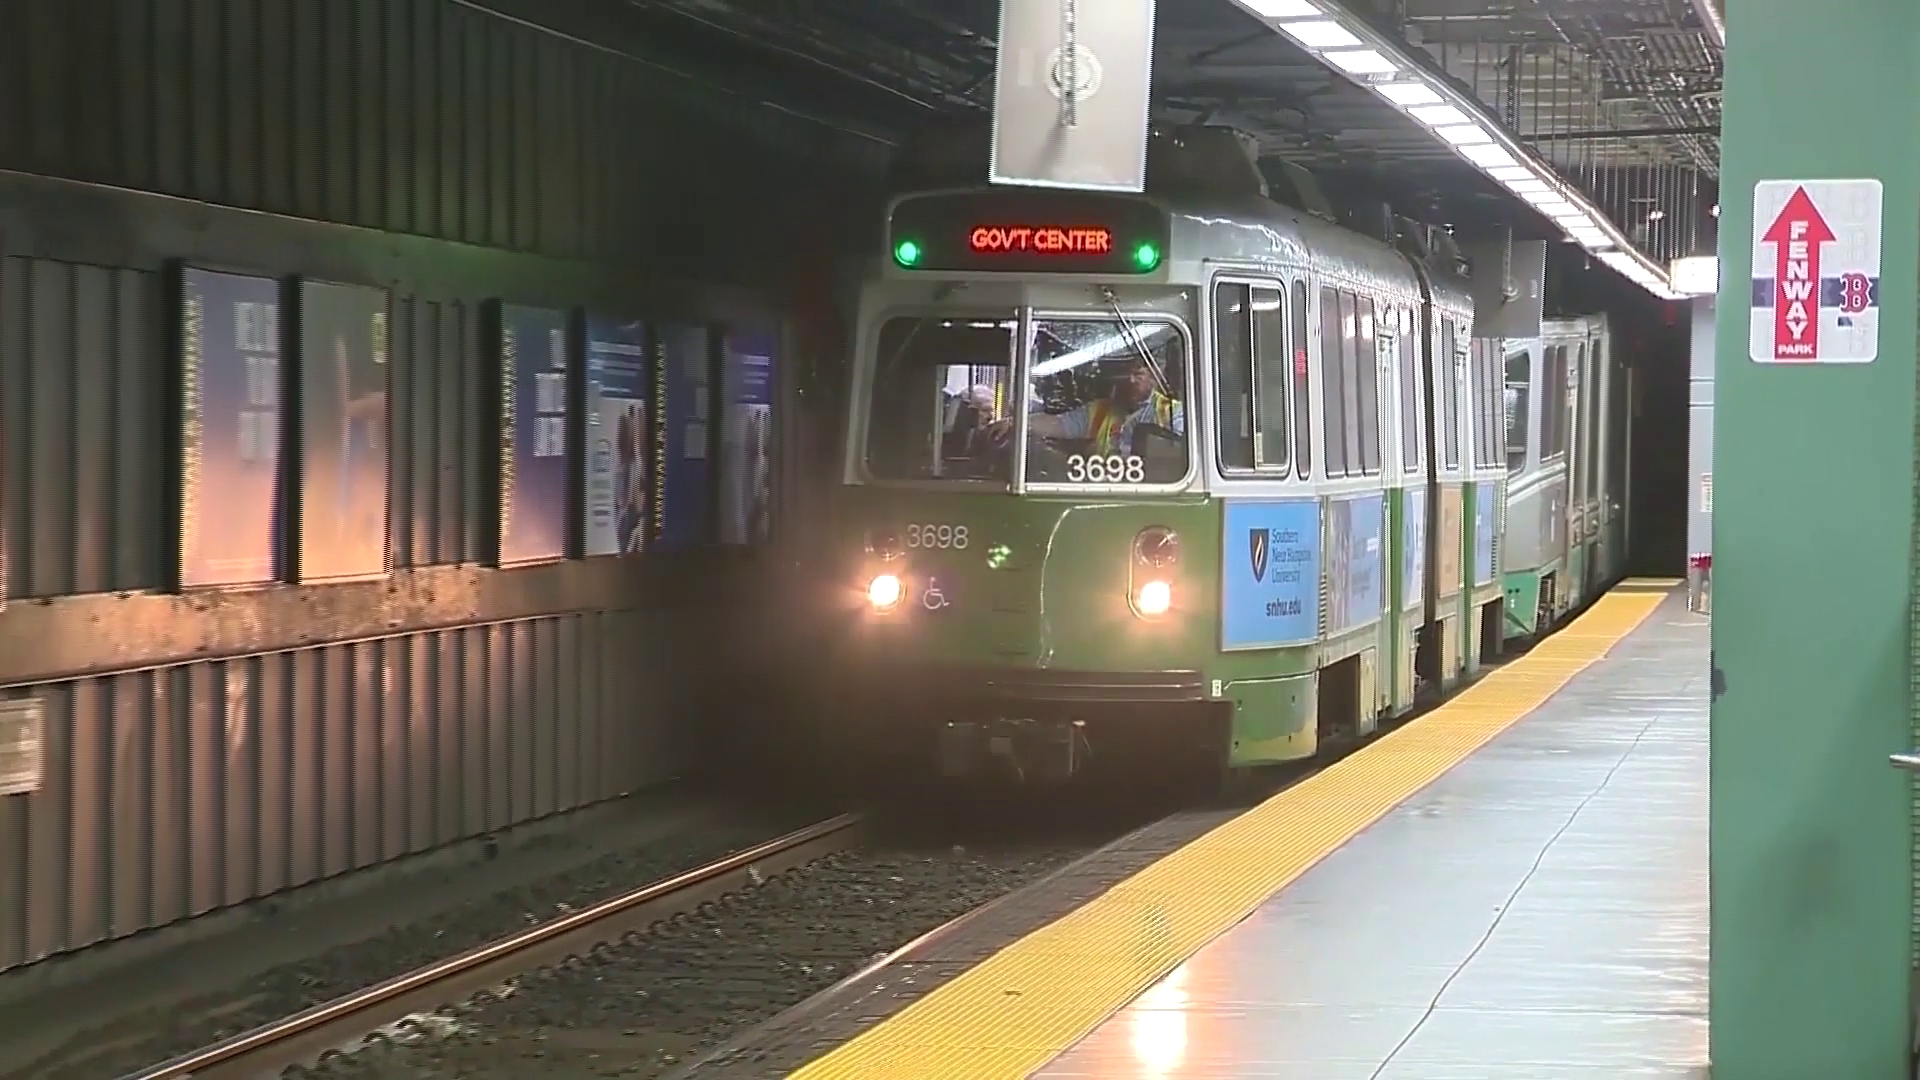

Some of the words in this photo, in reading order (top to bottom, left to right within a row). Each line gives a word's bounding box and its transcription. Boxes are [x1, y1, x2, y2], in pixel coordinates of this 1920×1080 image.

[971, 227, 1031, 250] GOV'T
[1033, 228, 1109, 252] CENTER
[1781, 220, 1814, 341] FENWAY
[1840, 271, 1873, 314] B
[1777, 343, 1814, 356] PARK
[1066, 454, 1145, 483] 3698
[906, 523, 969, 549] 3698
[1271, 568, 1300, 584] University
[1265, 596, 1301, 617] snhu.edu
